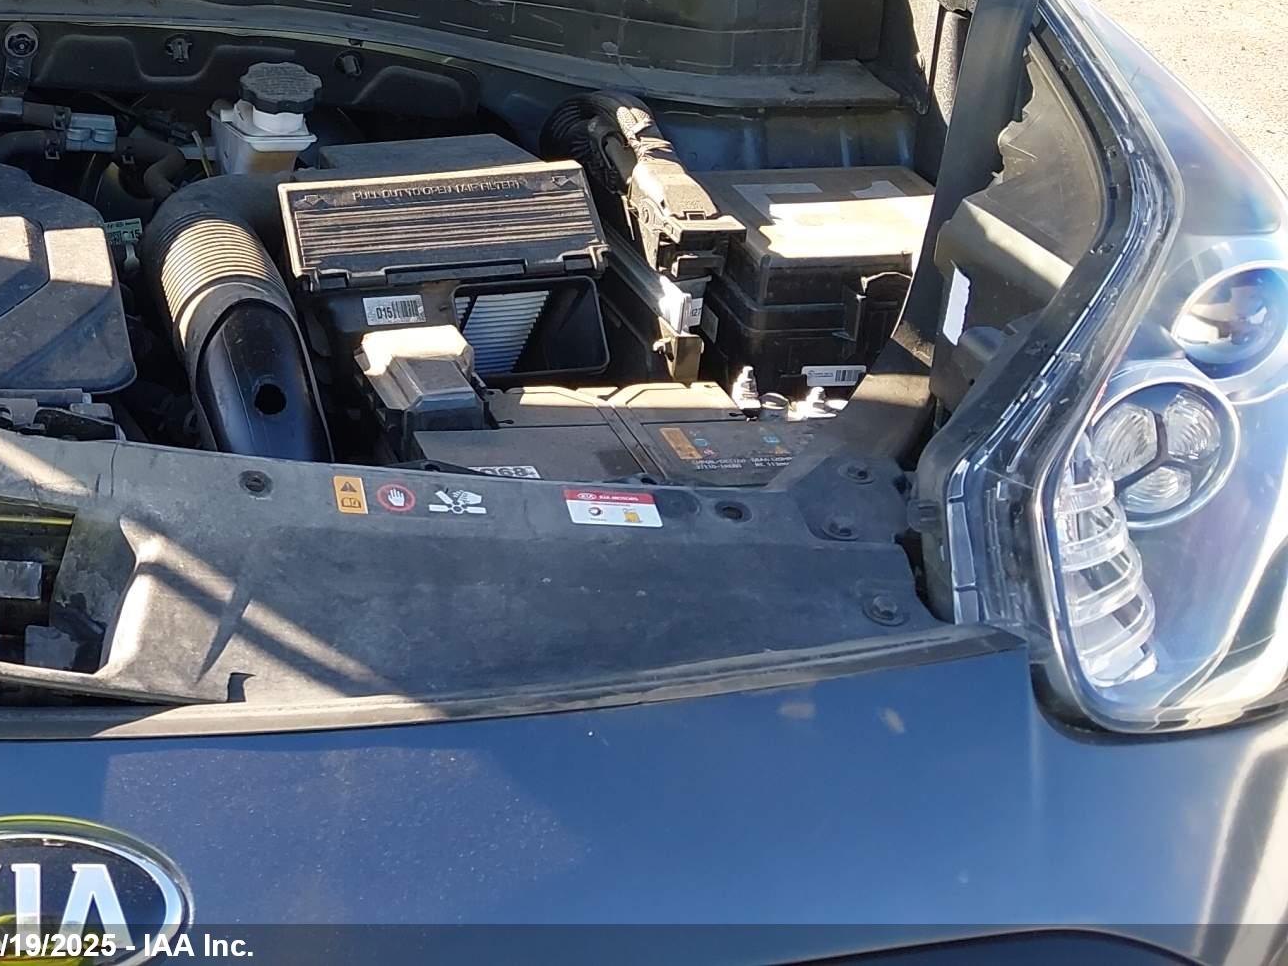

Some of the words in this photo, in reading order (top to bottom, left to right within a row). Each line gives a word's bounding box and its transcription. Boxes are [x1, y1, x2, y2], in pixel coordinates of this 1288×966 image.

[352, 190, 379, 201] PULL
[382, 188, 404, 198] OUT
[405, 187, 421, 197] TO
[422, 185, 451, 195] OPEN
[375, 306, 394, 320] D15
